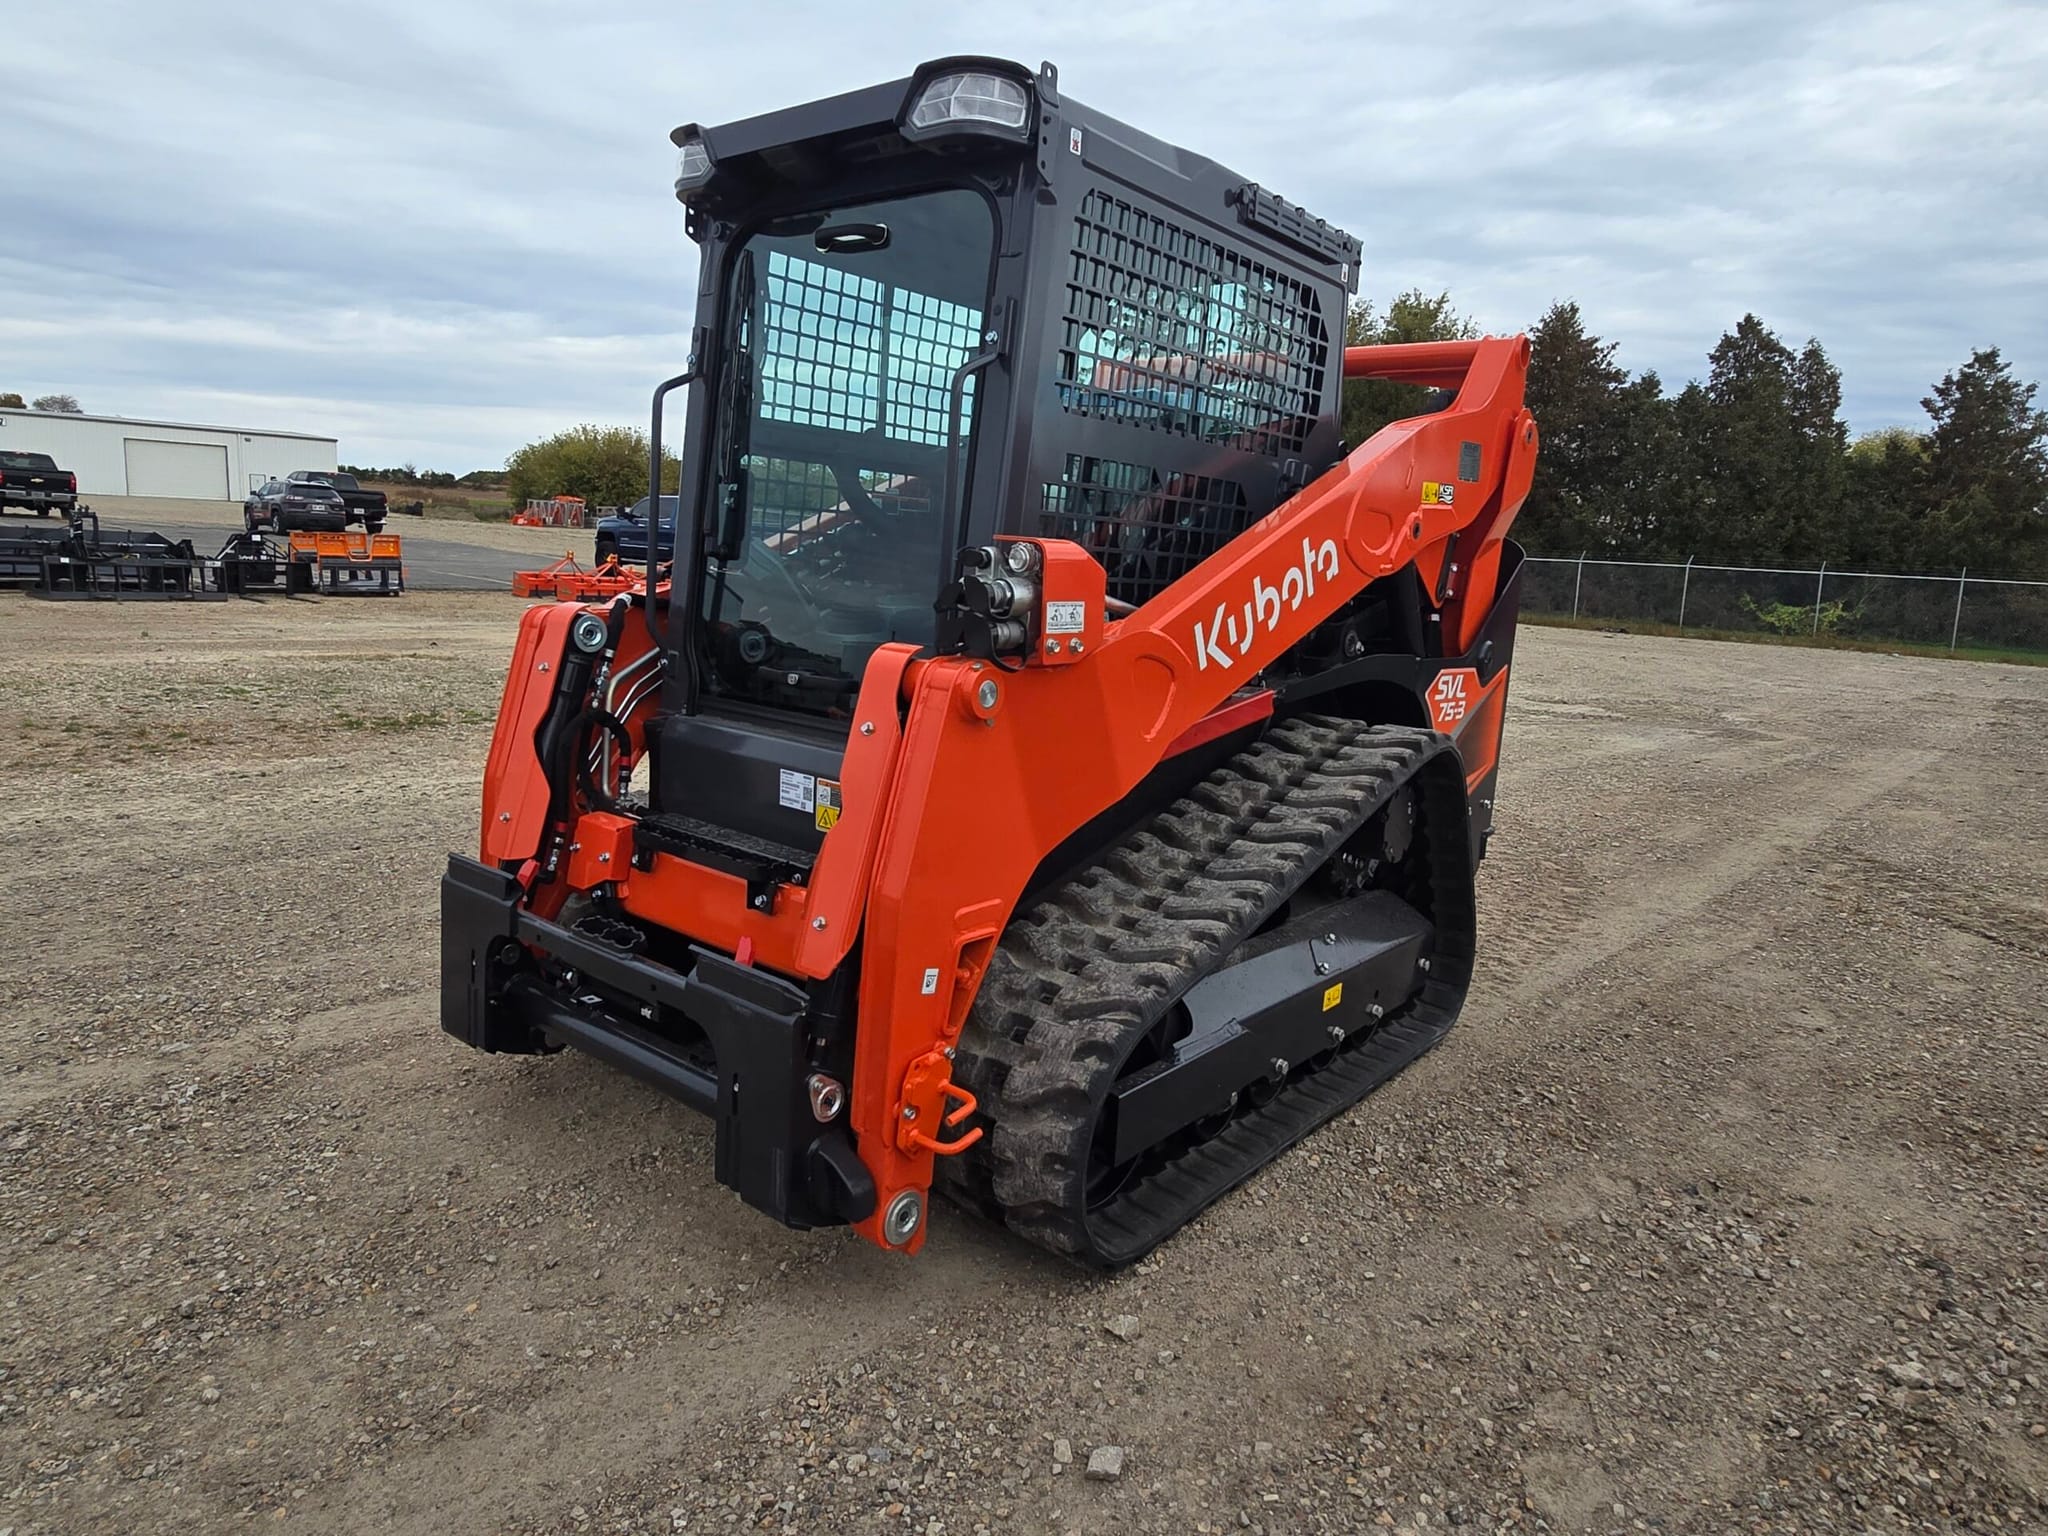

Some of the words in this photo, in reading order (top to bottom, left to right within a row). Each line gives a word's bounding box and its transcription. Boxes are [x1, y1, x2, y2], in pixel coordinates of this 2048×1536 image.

[1194, 536, 1340, 672] Kubota
[1434, 674, 1467, 701] SVL
[1437, 700, 1467, 722] 75-3
